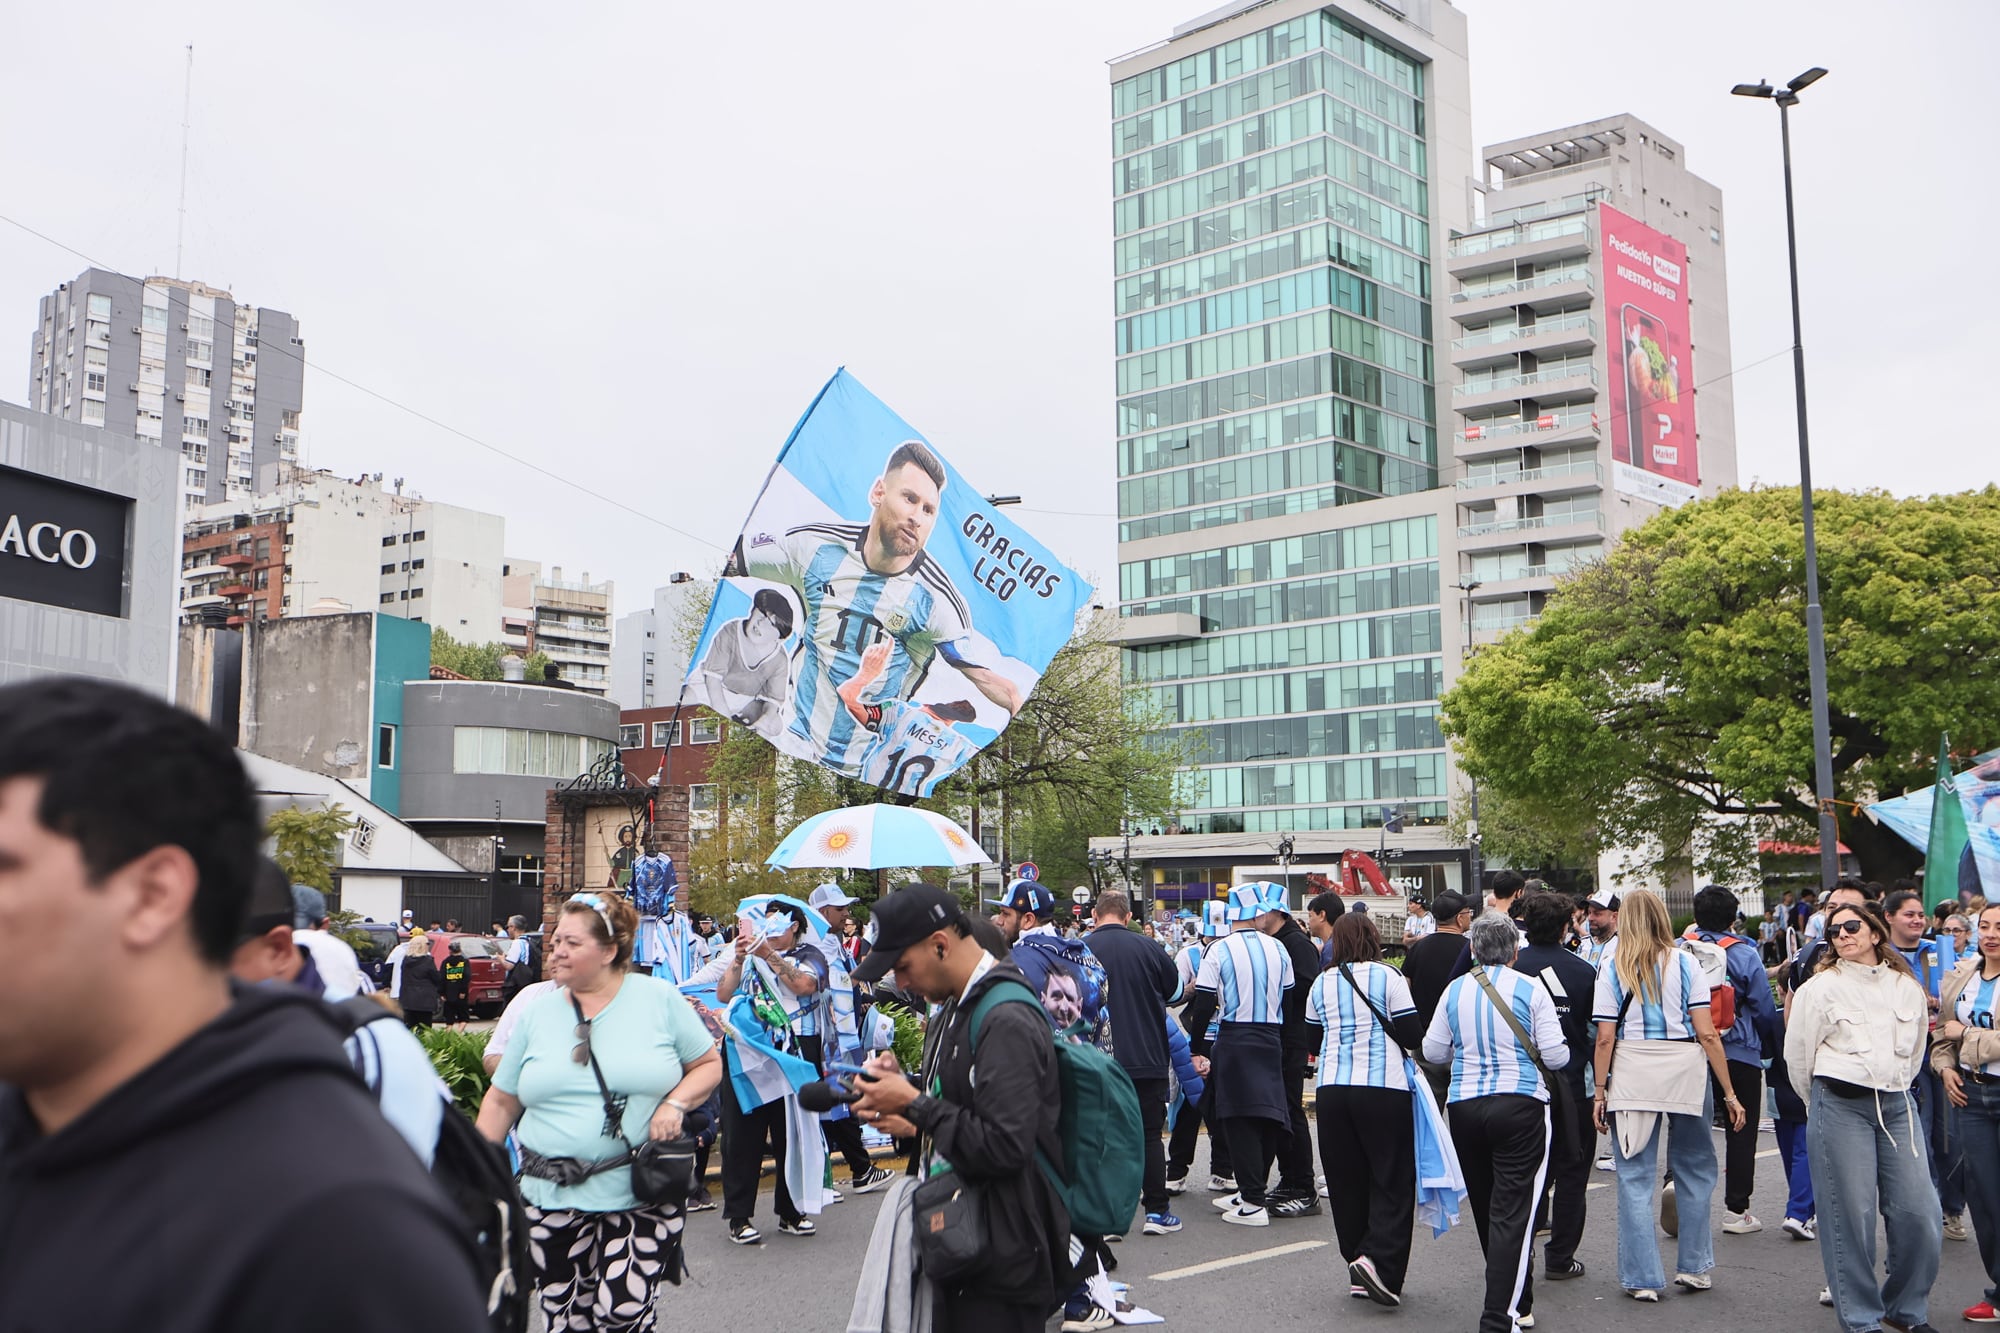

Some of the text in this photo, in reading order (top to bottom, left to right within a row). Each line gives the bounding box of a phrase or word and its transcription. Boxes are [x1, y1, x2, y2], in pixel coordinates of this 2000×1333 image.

[1609, 233, 1652, 266] PedidosYa
[1617, 264, 1677, 301] NUESTRO SÚPER
[1655, 448, 1675, 460] Market
[0, 514, 97, 569] ACO
[963, 513, 1061, 598] GRACIAS
[973, 556, 1018, 602] LEO
[830, 608, 884, 657] 10
[907, 723, 948, 751] MESSI
[879, 748, 935, 797] 10
